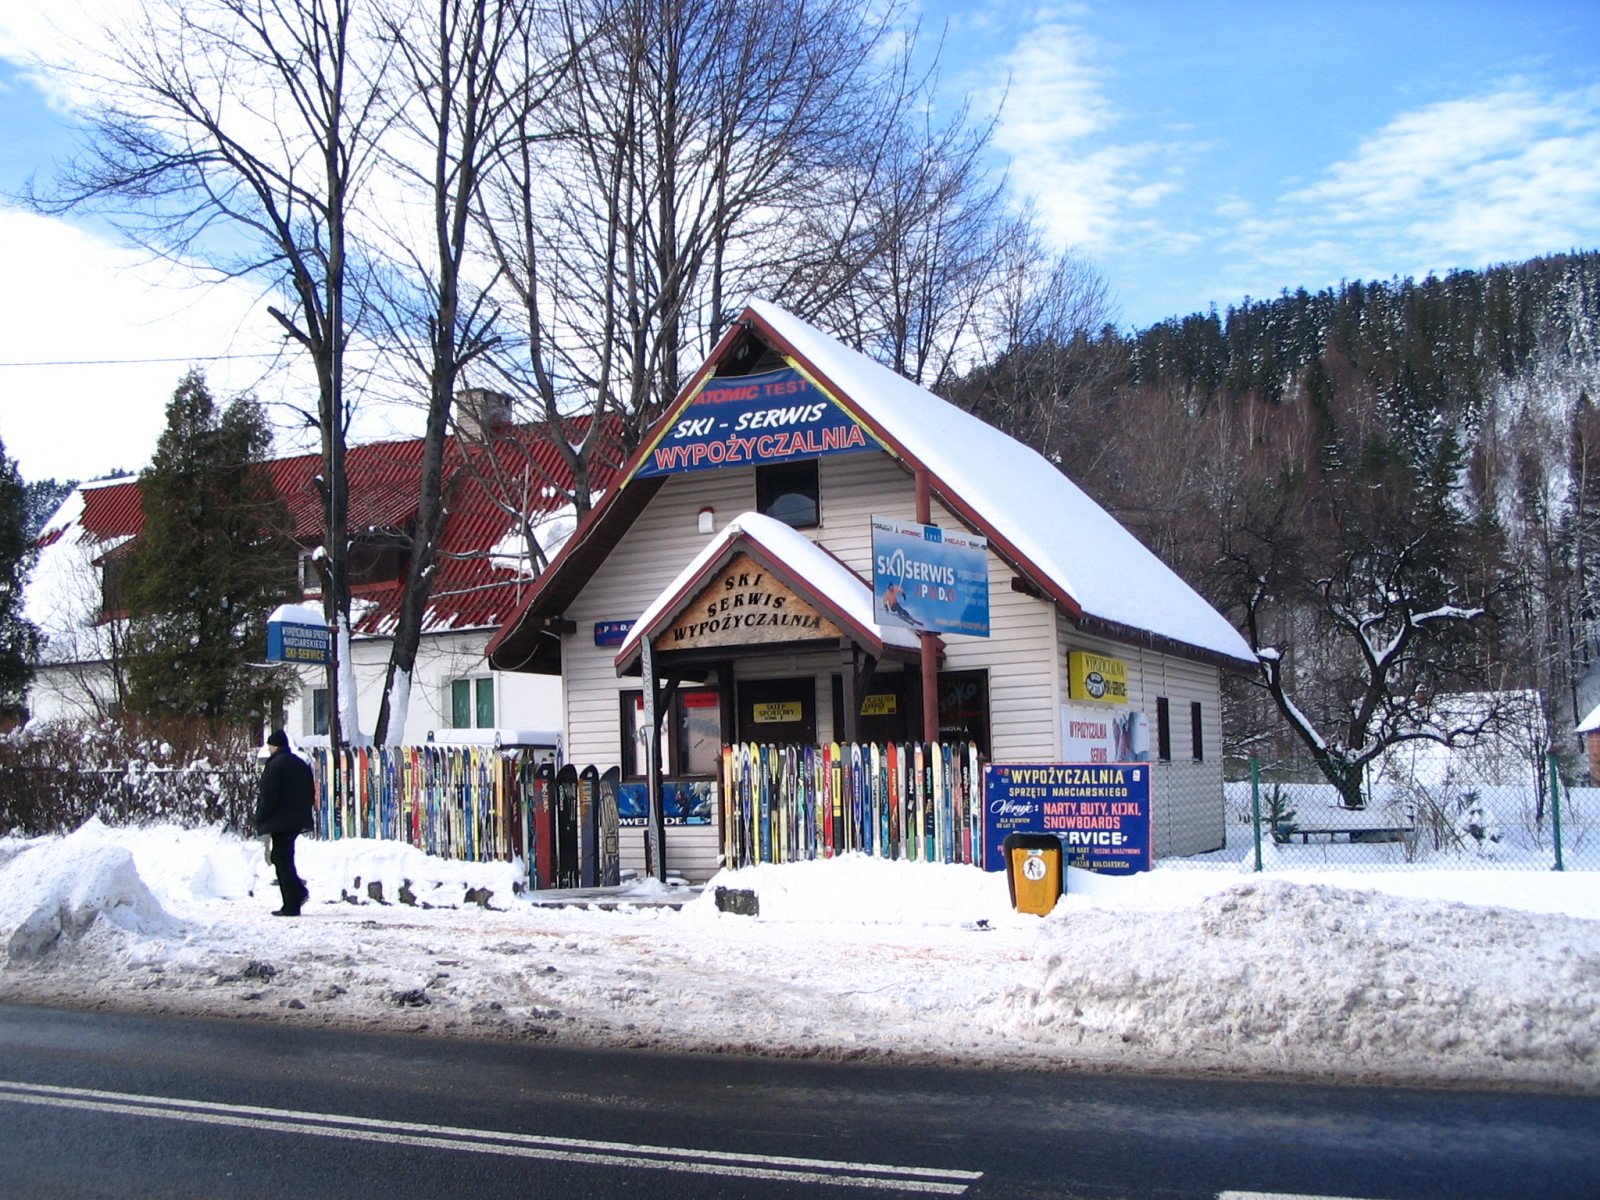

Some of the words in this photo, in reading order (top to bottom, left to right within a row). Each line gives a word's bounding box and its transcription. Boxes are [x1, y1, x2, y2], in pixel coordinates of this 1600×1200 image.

[691, 386, 760, 406] ATOMIC
[765, 379, 809, 397] TEST
[674, 417, 714, 438] SKI
[735, 403, 827, 431] SERWIS
[654, 424, 866, 470] WYPOŻYCZALNIA
[944, 537, 966, 547] HEAD
[725, 573, 763, 590] SKI
[905, 560, 955, 586] SERWIS
[673, 614, 821, 641] WYPOŻYCZALNIA
[642, 650, 654, 715] ATOMIC
[1012, 767, 1125, 784] WYPOŻYCZALNIA
[1009, 788, 1047, 798] SPRZĘTU
[1052, 788, 1128, 797] NARCIARSKIEGO
[1044, 803, 1079, 816] NARTY,
[1080, 803, 1109, 816] BUTY,
[1111, 803, 1142, 816] KIJKI,
[1044, 816, 1121, 830] SNOWBOARDS
